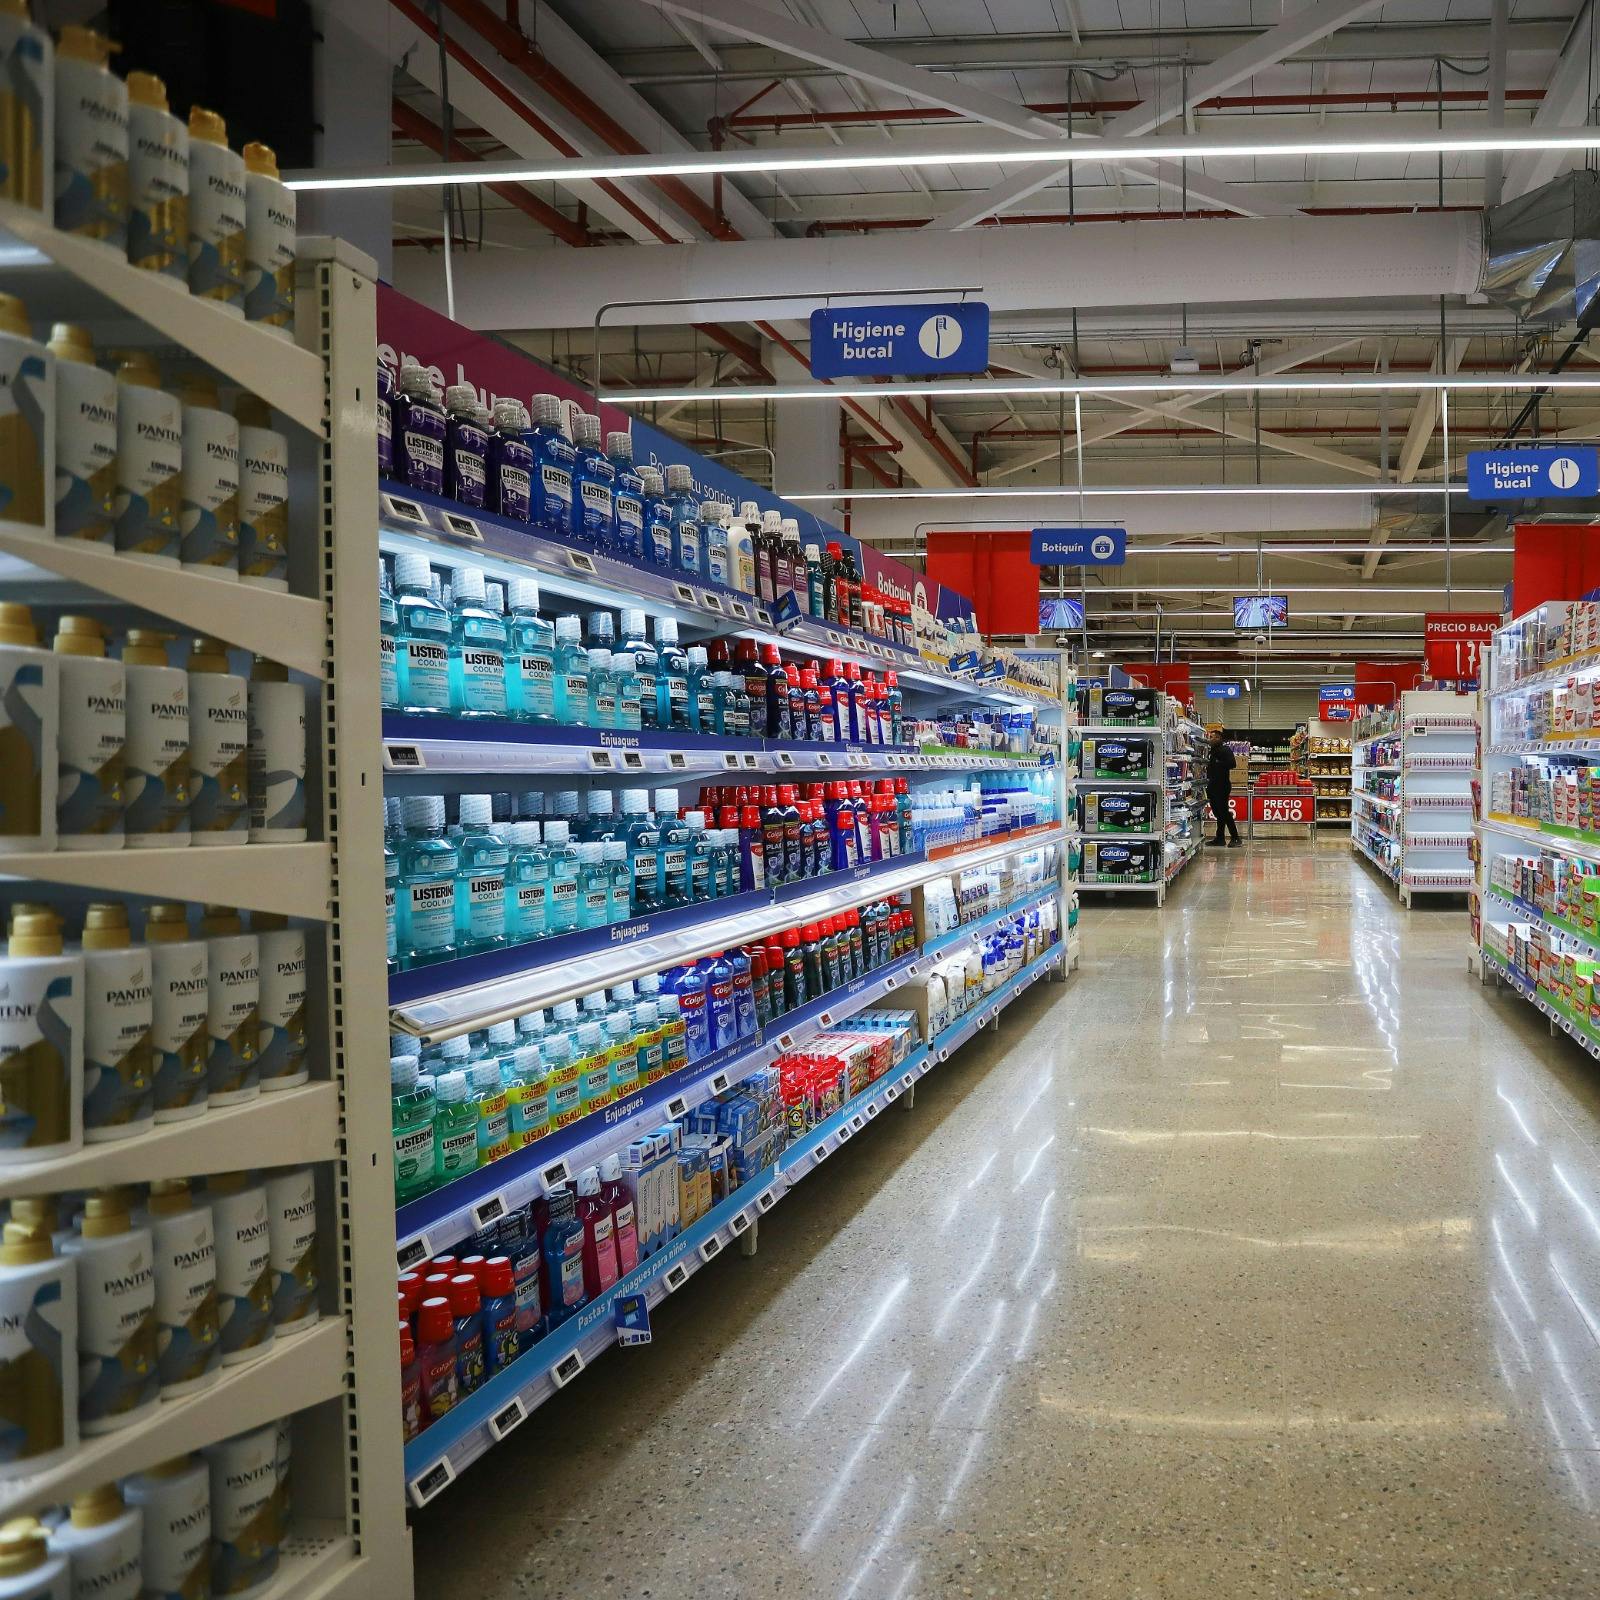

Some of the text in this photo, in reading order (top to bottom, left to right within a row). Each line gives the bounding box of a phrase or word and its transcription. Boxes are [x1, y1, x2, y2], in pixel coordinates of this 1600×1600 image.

[833, 322, 905, 342] Higiene
[843, 342, 893, 359] bucal
[413, 461, 425, 472] 14
[1485, 463, 1539, 477] Higiene
[462, 477, 473, 487] 14
[1494, 476, 1532, 489] bucal
[506, 490, 516, 500] 14
[1041, 542, 1084, 555] Botiquín
[1427, 623, 1498, 632] PRECIO BAJO
[418, 659, 437, 667] COOL
[1105, 694, 1135, 703] Cotidian
[600, 732, 640, 748] Enjuagues
[1098, 746, 1127, 755] Cotidian
[1100, 799, 1130, 808] Cotidian
[1263, 800, 1302, 808] PRECIO
[1263, 809, 1302, 821] BAJO
[1100, 849, 1130, 858] Cotidian
[478, 892, 494, 900] COOL
[421, 900, 440, 909] COOL
[611, 922, 649, 942] Enjuagues
[681, 1009, 704, 1019] PLAX
[605, 1097, 644, 1124] Enjuagues
[395, 1127, 432, 1151] LISTERINE
[442, 1132, 475, 1150] LISTERINE
[578, 1240, 687, 1331] Pastas y enjuagues para niños
